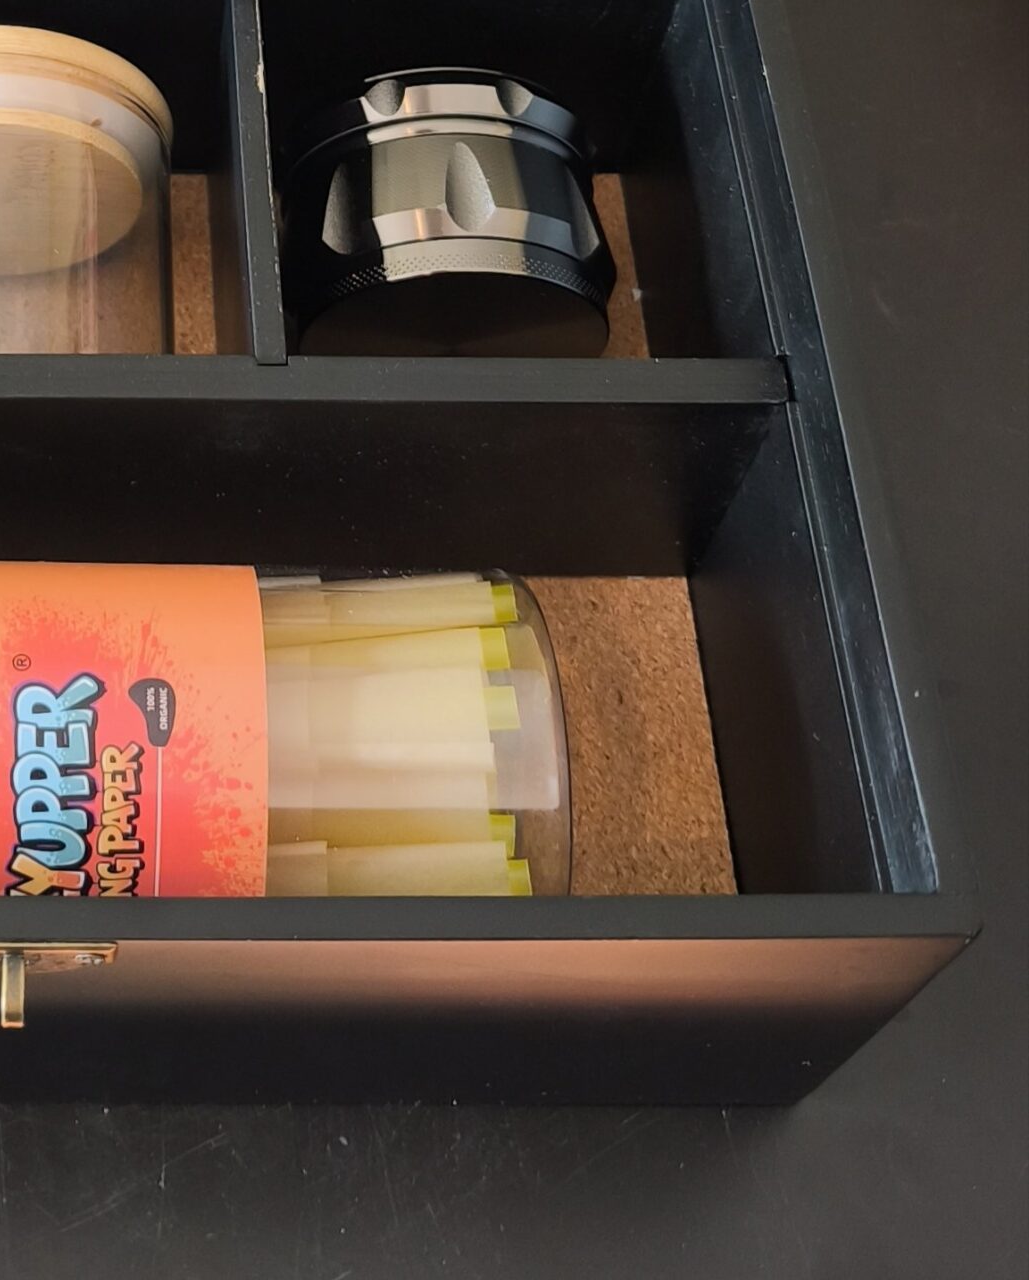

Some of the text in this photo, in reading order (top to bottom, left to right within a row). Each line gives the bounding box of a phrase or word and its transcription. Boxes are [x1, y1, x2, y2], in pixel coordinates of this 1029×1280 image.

[146, 686, 156, 712] 100%
[159, 687, 168, 731] ORGANIC
[97, 742, 143, 856] PAPER
